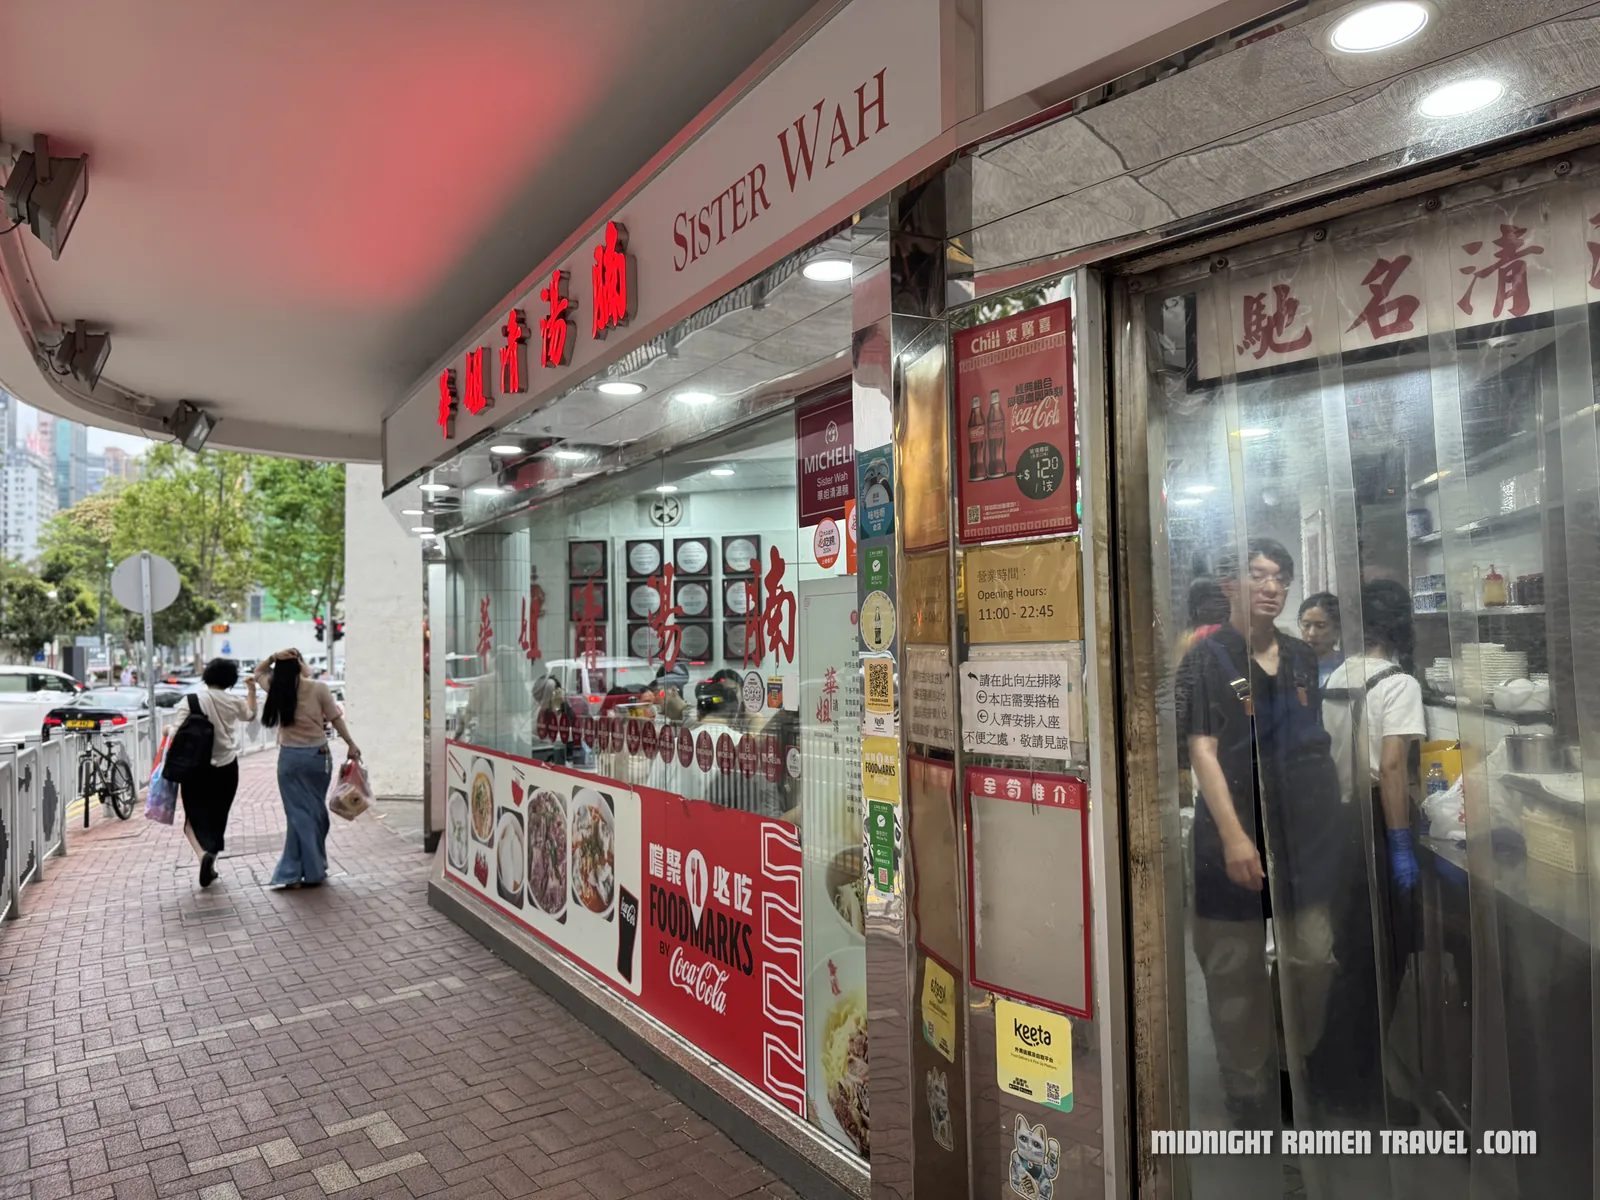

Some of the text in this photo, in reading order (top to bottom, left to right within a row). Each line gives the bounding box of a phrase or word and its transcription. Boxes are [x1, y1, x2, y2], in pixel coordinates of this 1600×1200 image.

[673, 66, 890, 272] SISTER WAH
[1236, 212, 1600, 360] 馳名清
[1005, 316, 1051, 344] 爽驚喜
[804, 444, 855, 475] MICHELI
[816, 471, 849, 488] Sister Wah
[977, 586, 1047, 601] Opening Hours:
[978, 607, 1010, 620] 11:00
[1020, 604, 1054, 618] 22:45
[979, 674, 1062, 688] 請在此向左排隊
[988, 693, 1060, 709] 本店需要搭枱
[989, 712, 1061, 729] 人齊安排入座
[964, 731, 1069, 751] 不便之處，敬請見諒
[983, 777, 1067, 805] 至筍推介
[713, 865, 753, 916] 必吃
[650, 883, 753, 977] FOODMARKS
[659, 940, 671, 957] BY
[669, 946, 730, 1015] Coca-Cola
[1014, 1018, 1052, 1047] keeta
